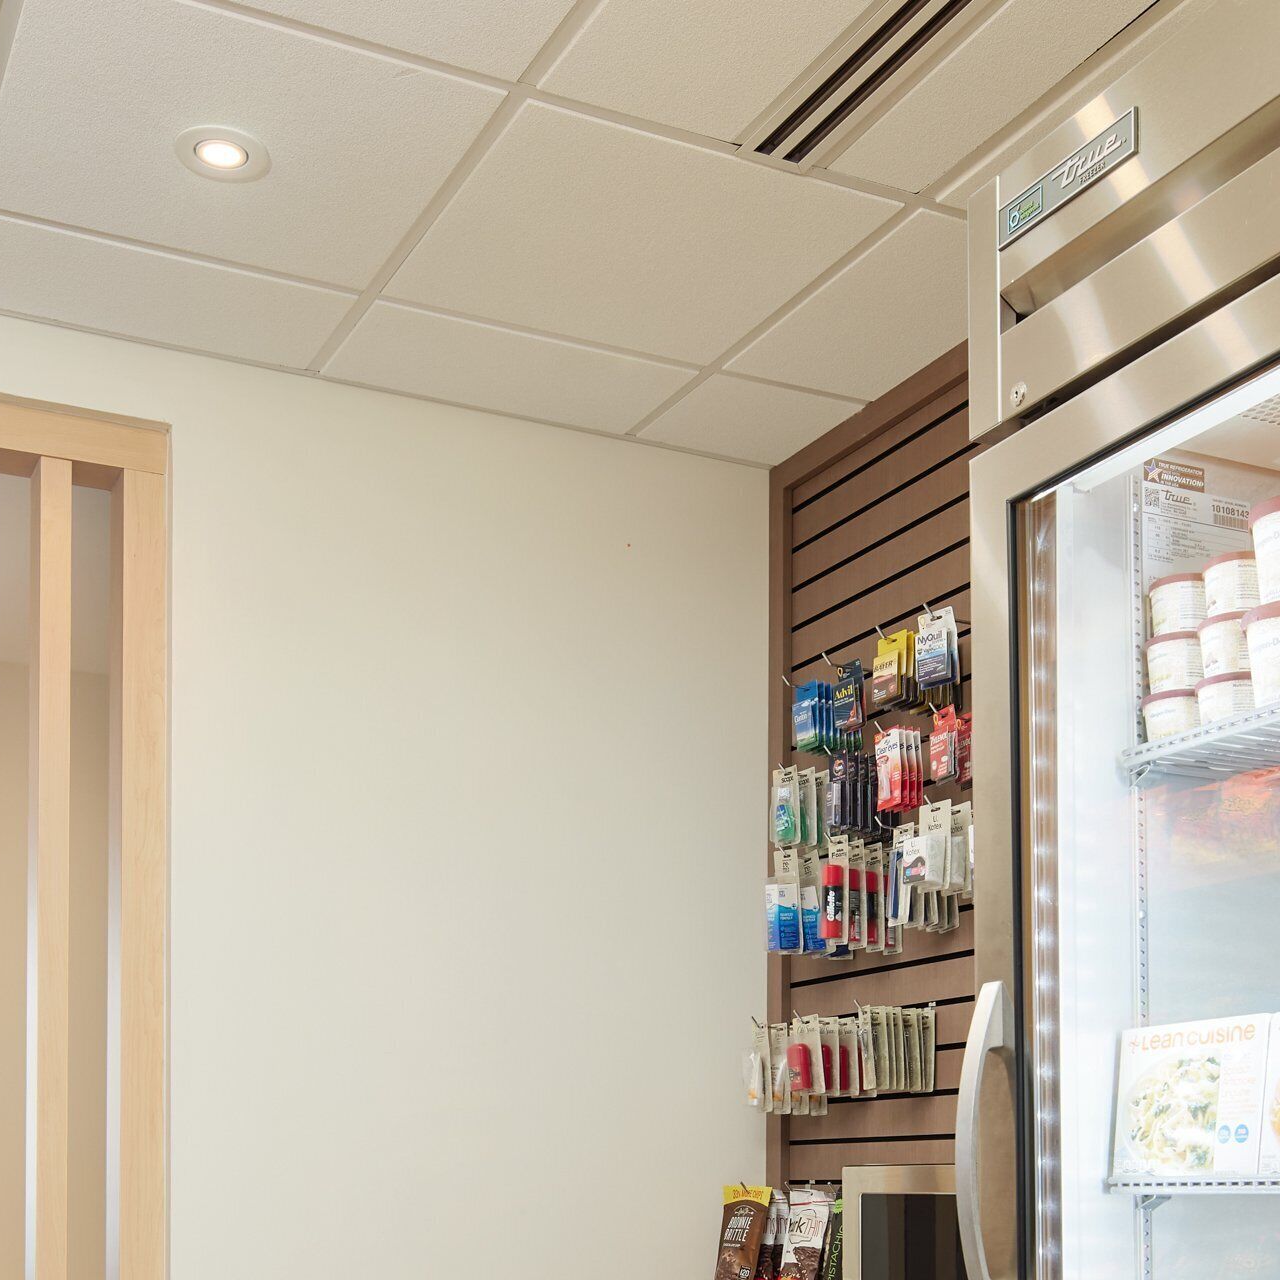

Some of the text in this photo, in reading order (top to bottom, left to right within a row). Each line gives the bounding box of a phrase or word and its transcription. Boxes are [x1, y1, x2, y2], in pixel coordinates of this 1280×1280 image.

[918, 630, 943, 645] NyQuil
[834, 686, 854, 700] Advil
[826, 889, 836, 922] Gillette
[1142, 1031, 1184, 1052] Lean
[727, 1216, 753, 1230] BROWNIE
[723, 1228, 748, 1242] BRITTLE
